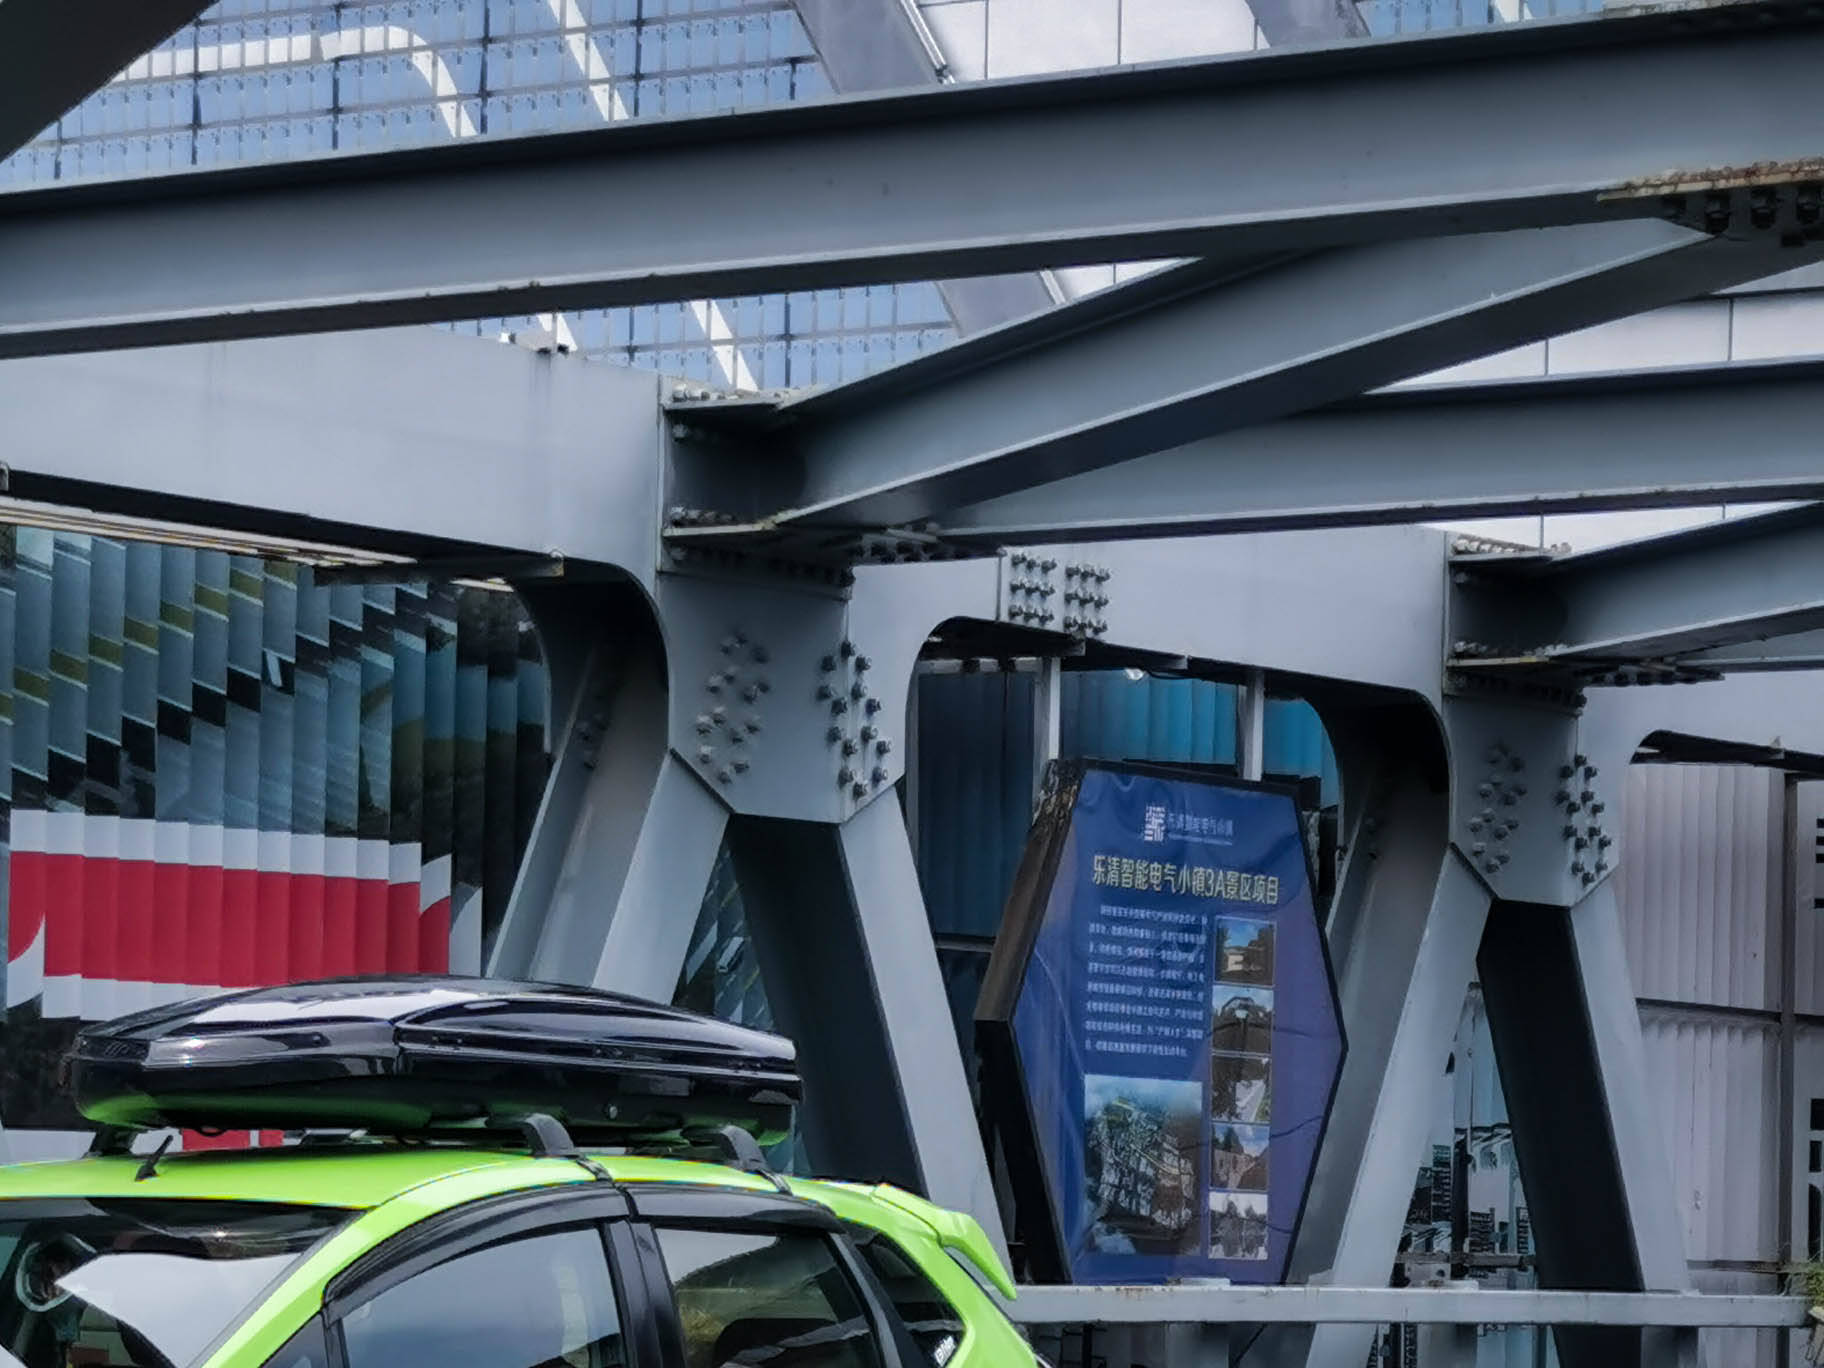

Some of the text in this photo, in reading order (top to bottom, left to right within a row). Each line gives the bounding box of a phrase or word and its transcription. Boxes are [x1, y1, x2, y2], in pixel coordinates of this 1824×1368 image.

[1092, 854, 1280, 905] 乐清智能电气小镇3A景区项目
